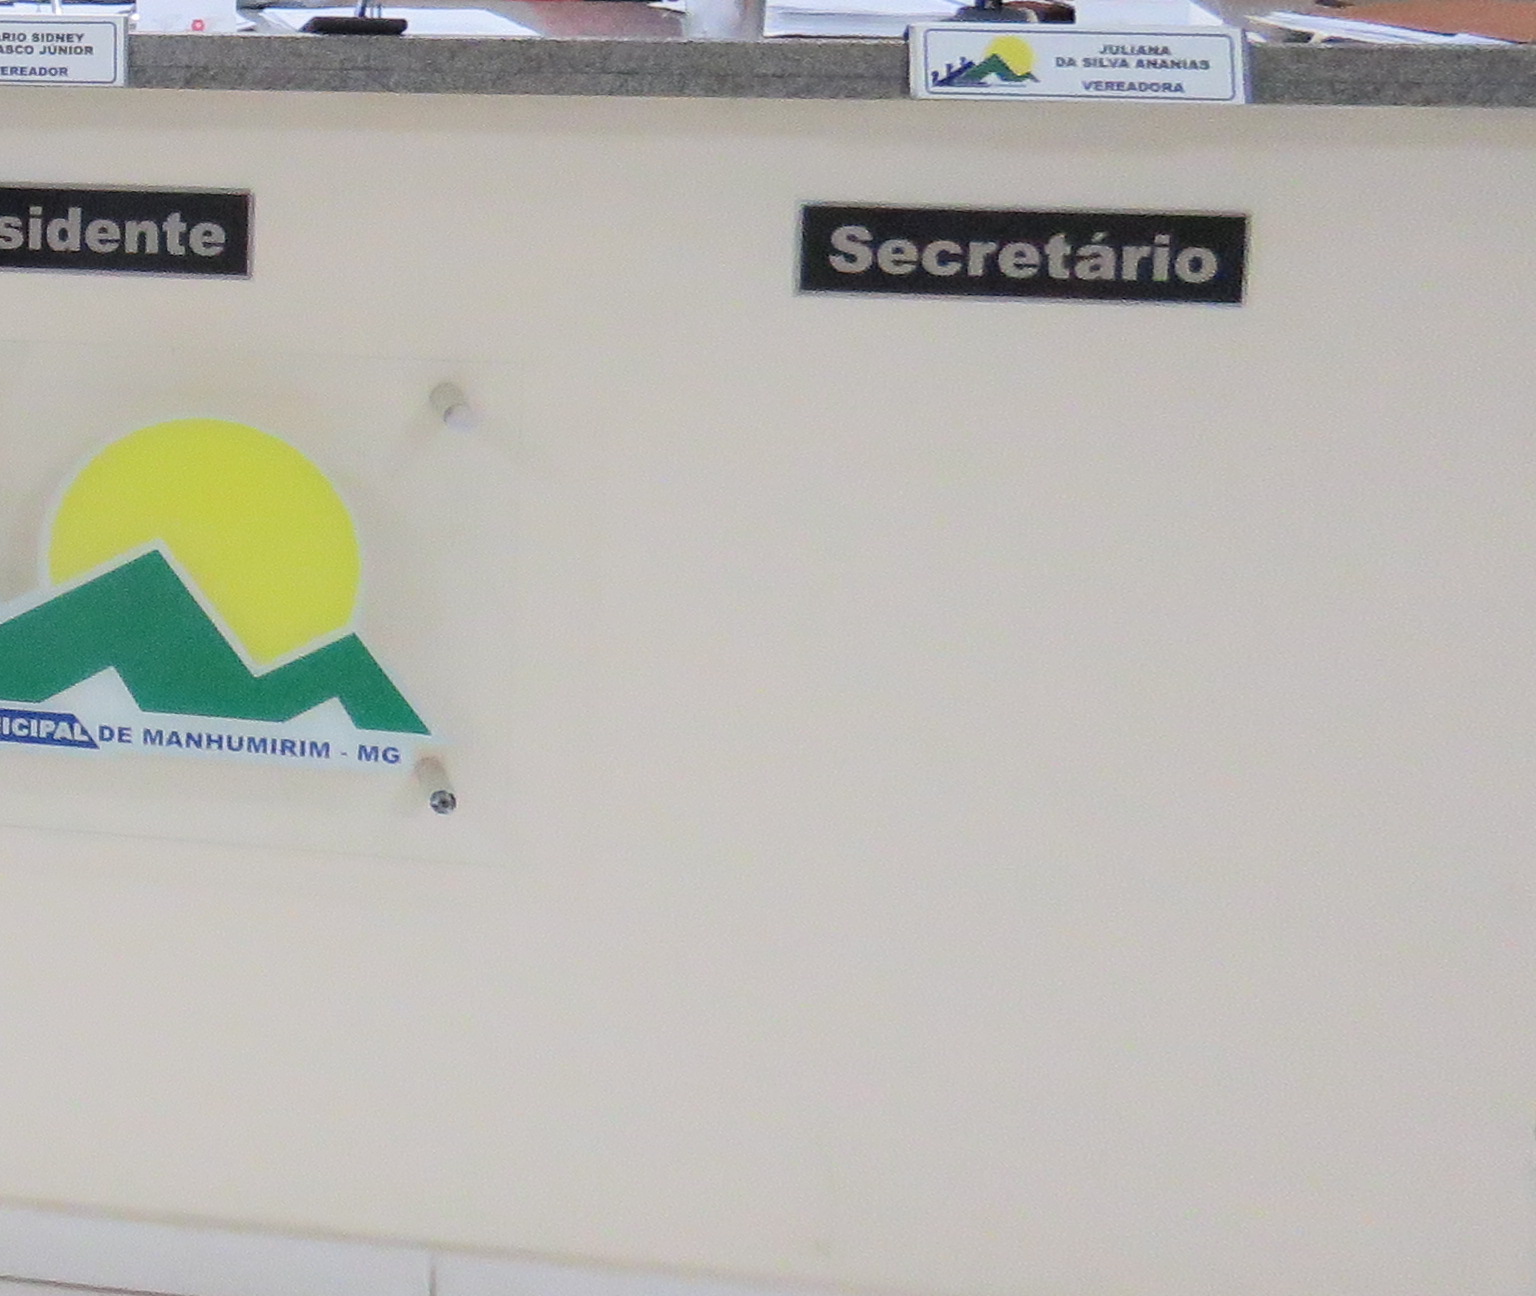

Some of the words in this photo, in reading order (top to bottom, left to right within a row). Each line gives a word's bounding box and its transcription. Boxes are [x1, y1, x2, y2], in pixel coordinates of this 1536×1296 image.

[31, 32, 85, 43] SIDNEY
[1099, 44, 1171, 55] JULIANA
[1055, 56, 1077, 67] DA
[1082, 57, 1129, 68] SILVA
[1135, 58, 1211, 70] ANANIAS
[1082, 80, 1186, 93] VEREADORA
[828, 225, 1219, 284] Secretário
[98, 725, 132, 744] DE
[143, 728, 330, 759] MANHUMIRIM
[357, 745, 402, 765] MG
